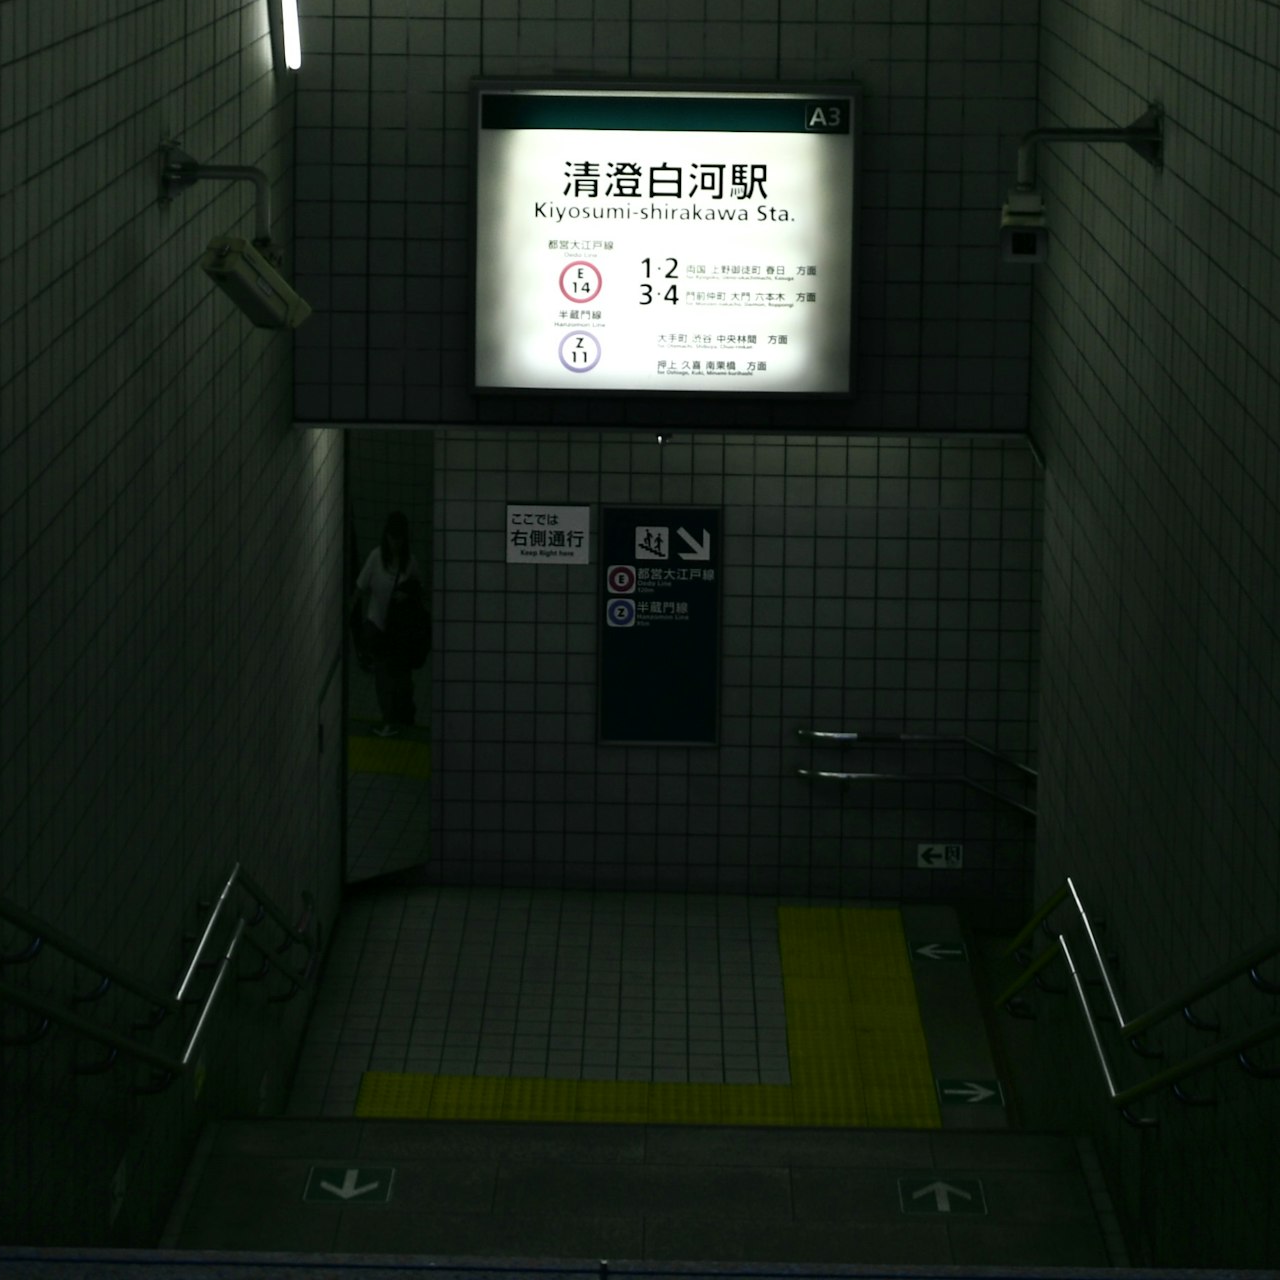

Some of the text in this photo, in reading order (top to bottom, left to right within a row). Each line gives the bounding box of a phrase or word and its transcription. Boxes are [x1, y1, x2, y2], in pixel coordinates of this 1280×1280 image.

[809, 106, 841, 127] A3
[562, 160, 768, 201] 清澄白河駅
[534, 201, 796, 223] Kiyosumi-shirakawa Sta.
[548, 239, 614, 251] 都営大江戸線
[577, 268, 584, 279] E
[796, 265, 817, 276] 方面
[572, 281, 591, 294] 14
[731, 292, 751, 302] 大門
[755, 292, 785, 302] 六本木
[796, 292, 817, 303] 方面
[558, 309, 602, 320] 半蔵門線
[575, 337, 585, 349] Z
[658, 333, 687, 344] 大手町
[716, 334, 757, 344] 中央林間
[767, 334, 788, 345] 方面
[571, 351, 588, 363] 11
[657, 360, 677, 370] 押上
[681, 360, 701, 370] 久喜
[747, 361, 767, 371] 方面
[511, 513, 559, 526] ここでは
[510, 529, 584, 548] 右側通行
[520, 549, 574, 558] Keep Right here
[618, 575, 625, 584] E
[637, 567, 715, 581] 都営大江戸線
[617, 608, 625, 618] Z
[637, 601, 689, 614] 半蔵門線
